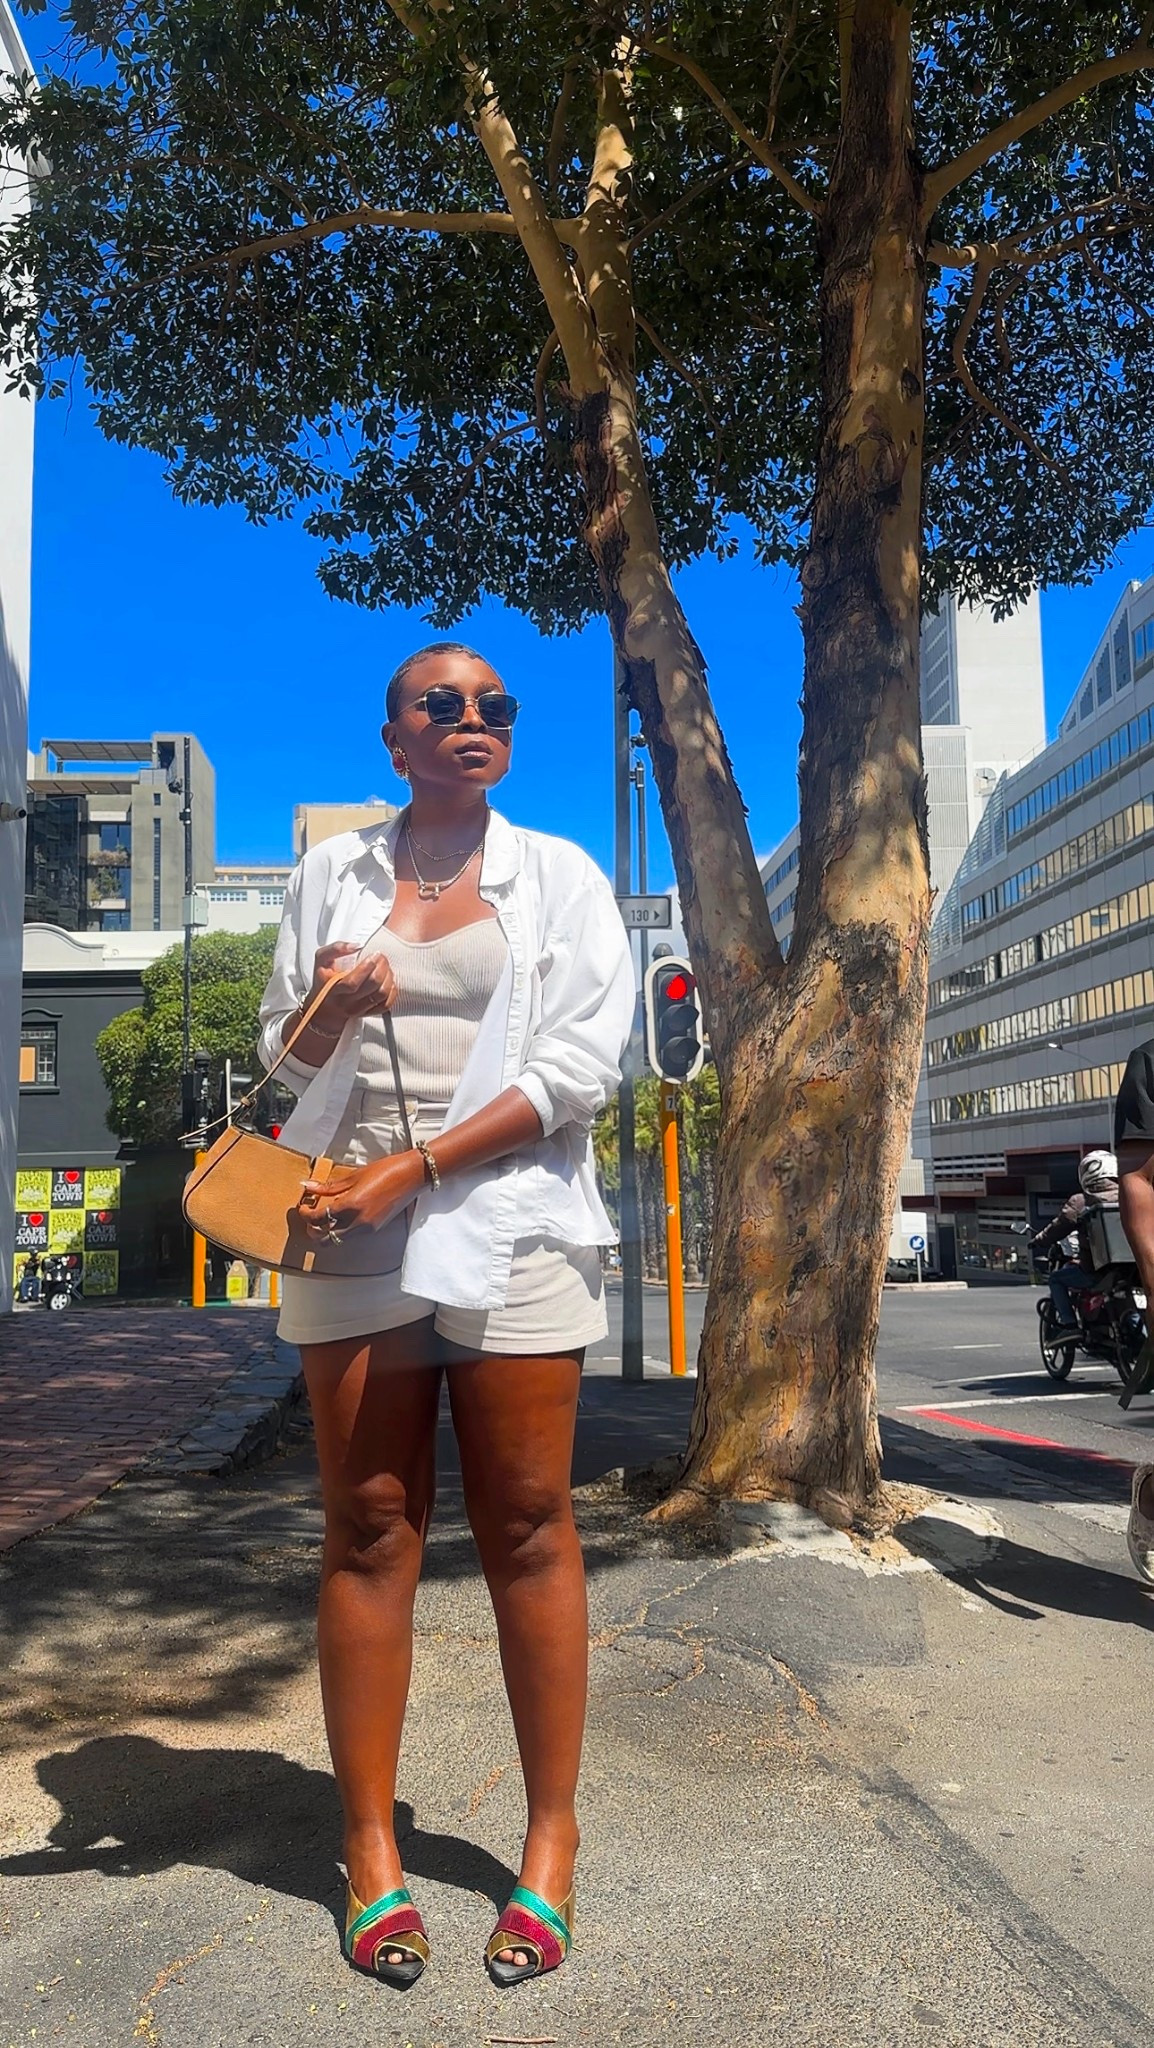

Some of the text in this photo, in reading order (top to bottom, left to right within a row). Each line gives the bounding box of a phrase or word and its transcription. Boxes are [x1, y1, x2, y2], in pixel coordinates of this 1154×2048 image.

[631, 910, 650, 922] 130
[57, 1171, 65, 1184] I
[54, 1183, 82, 1194] CAPE
[52, 1191, 84, 1202] TOWN
[21, 1214, 29, 1227] I
[91, 1212, 99, 1225] I
[17, 1226, 46, 1237] CAPE
[88, 1225, 116, 1236] CAPE
[15, 1234, 48, 1246] TOWN
[86, 1233, 117, 1243] TOWN
